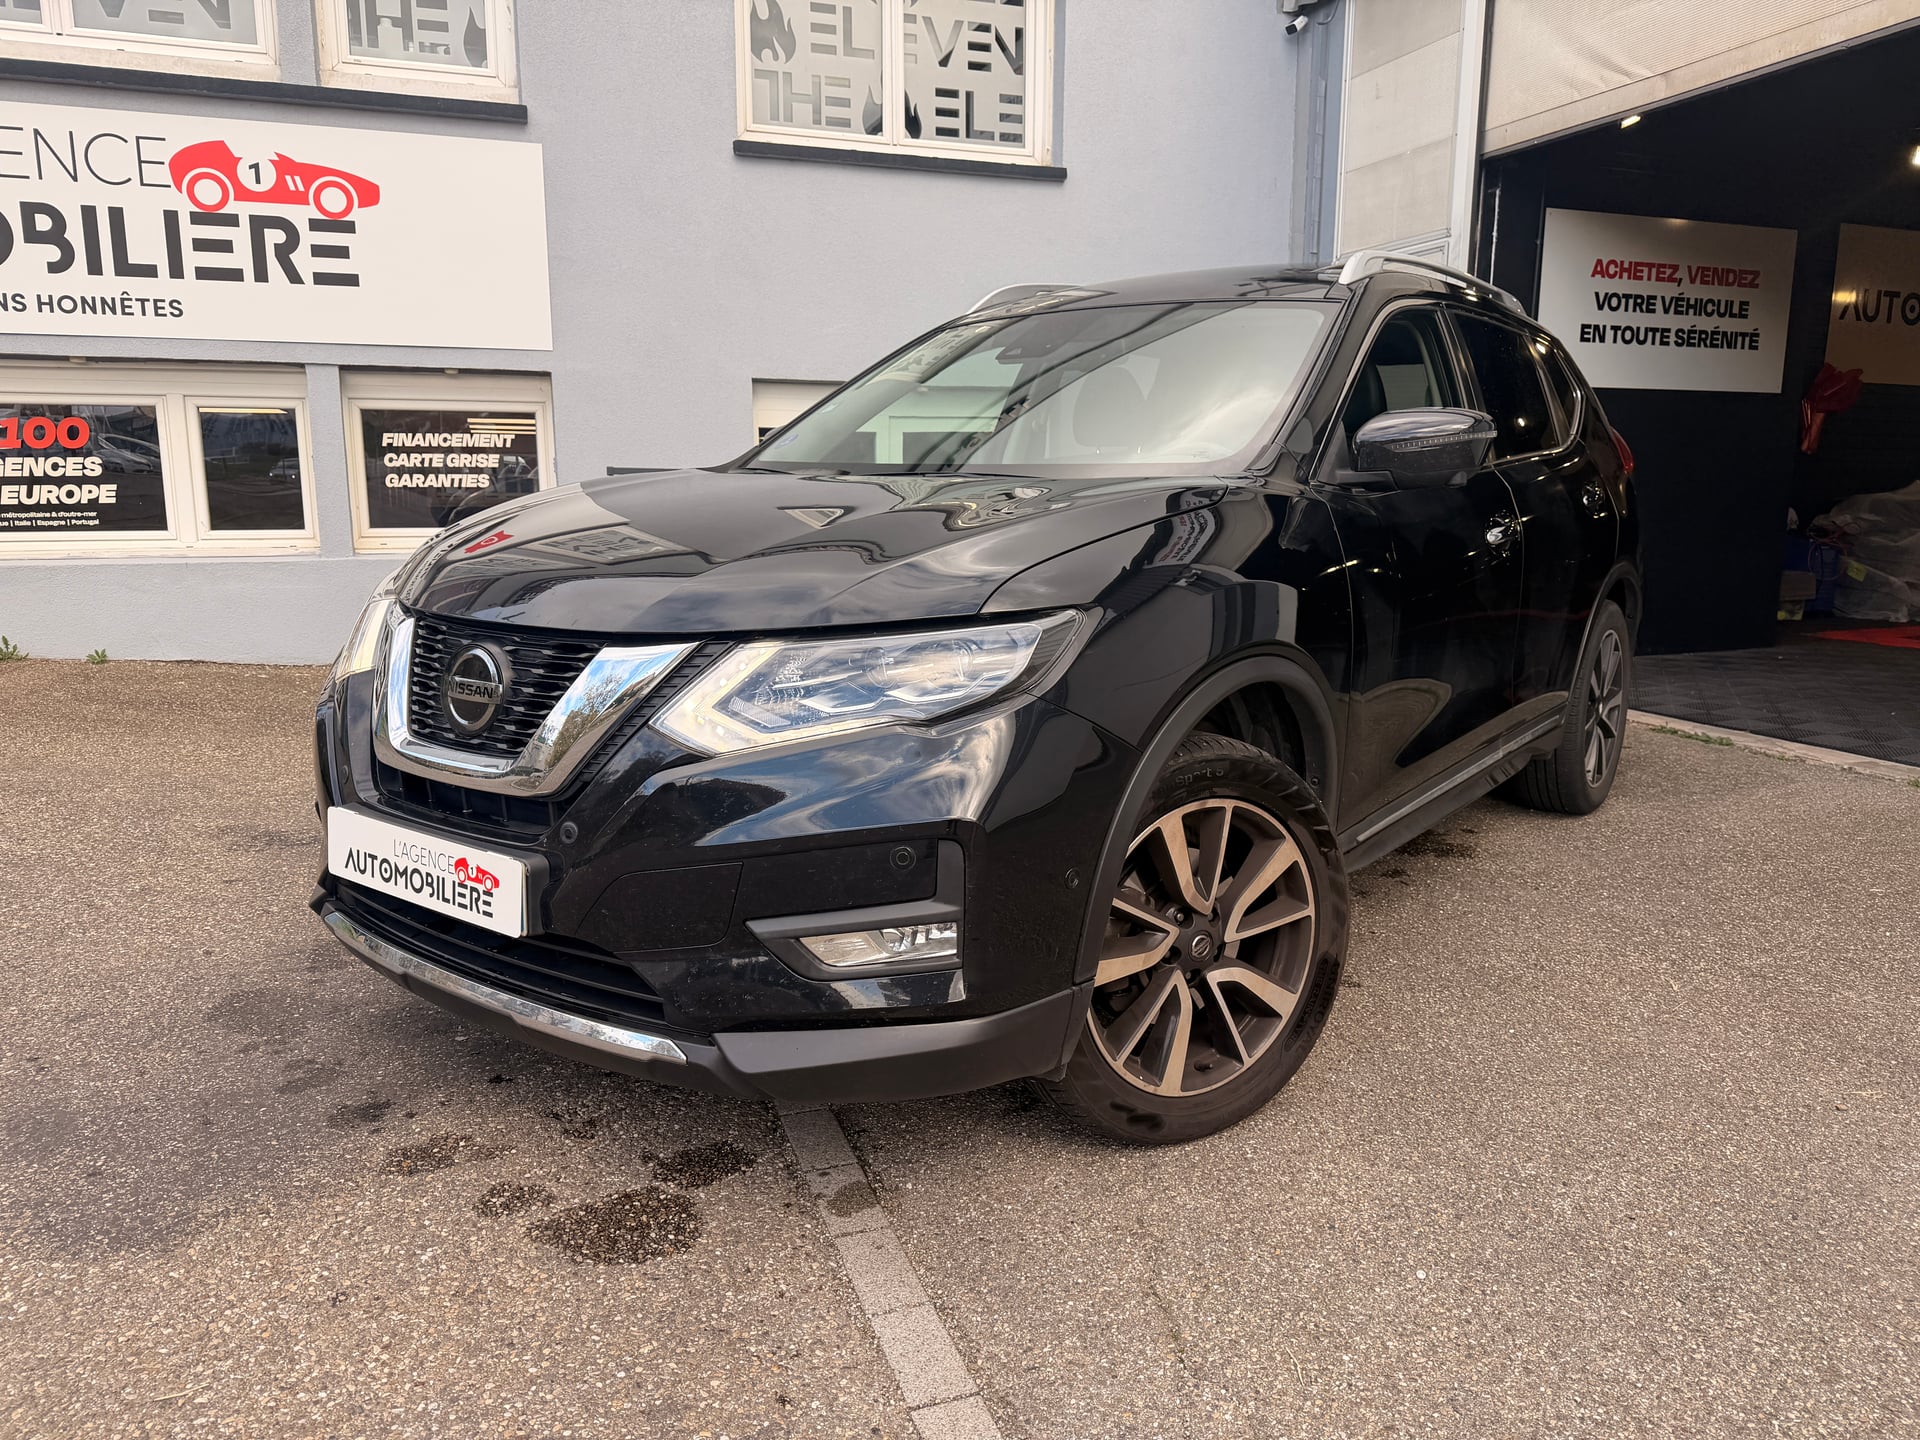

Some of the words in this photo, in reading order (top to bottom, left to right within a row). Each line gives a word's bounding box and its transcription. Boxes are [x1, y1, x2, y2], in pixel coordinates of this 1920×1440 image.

[0, 201, 360, 287] BILIERE
[1591, 258, 1683, 287] ACHETEZ,
[1687, 265, 1760, 288] VENDEZ
[36, 291, 184, 318] HONNÊTES
[1595, 292, 1657, 313] VOTRE
[1661, 292, 1750, 319] VÉHICULE
[1579, 323, 1607, 343] EN
[1610, 325, 1671, 346] TOUTE
[1674, 324, 1760, 350] SÉRÉNITÉ
[382, 432, 515, 448] FINANCEMENT
[383, 453, 444, 468] CARTE
[446, 453, 500, 468] GRISE
[385, 473, 490, 488] GARANTIES
[0, 484, 117, 505] EUROPE
[36, 519, 65, 528] Espagne
[71, 518, 99, 527] Portugal
[449, 680, 493, 699] NISSAN
[393, 838, 455, 875] L'AGENCE
[345, 847, 494, 919] AUTOMOBILIERE
